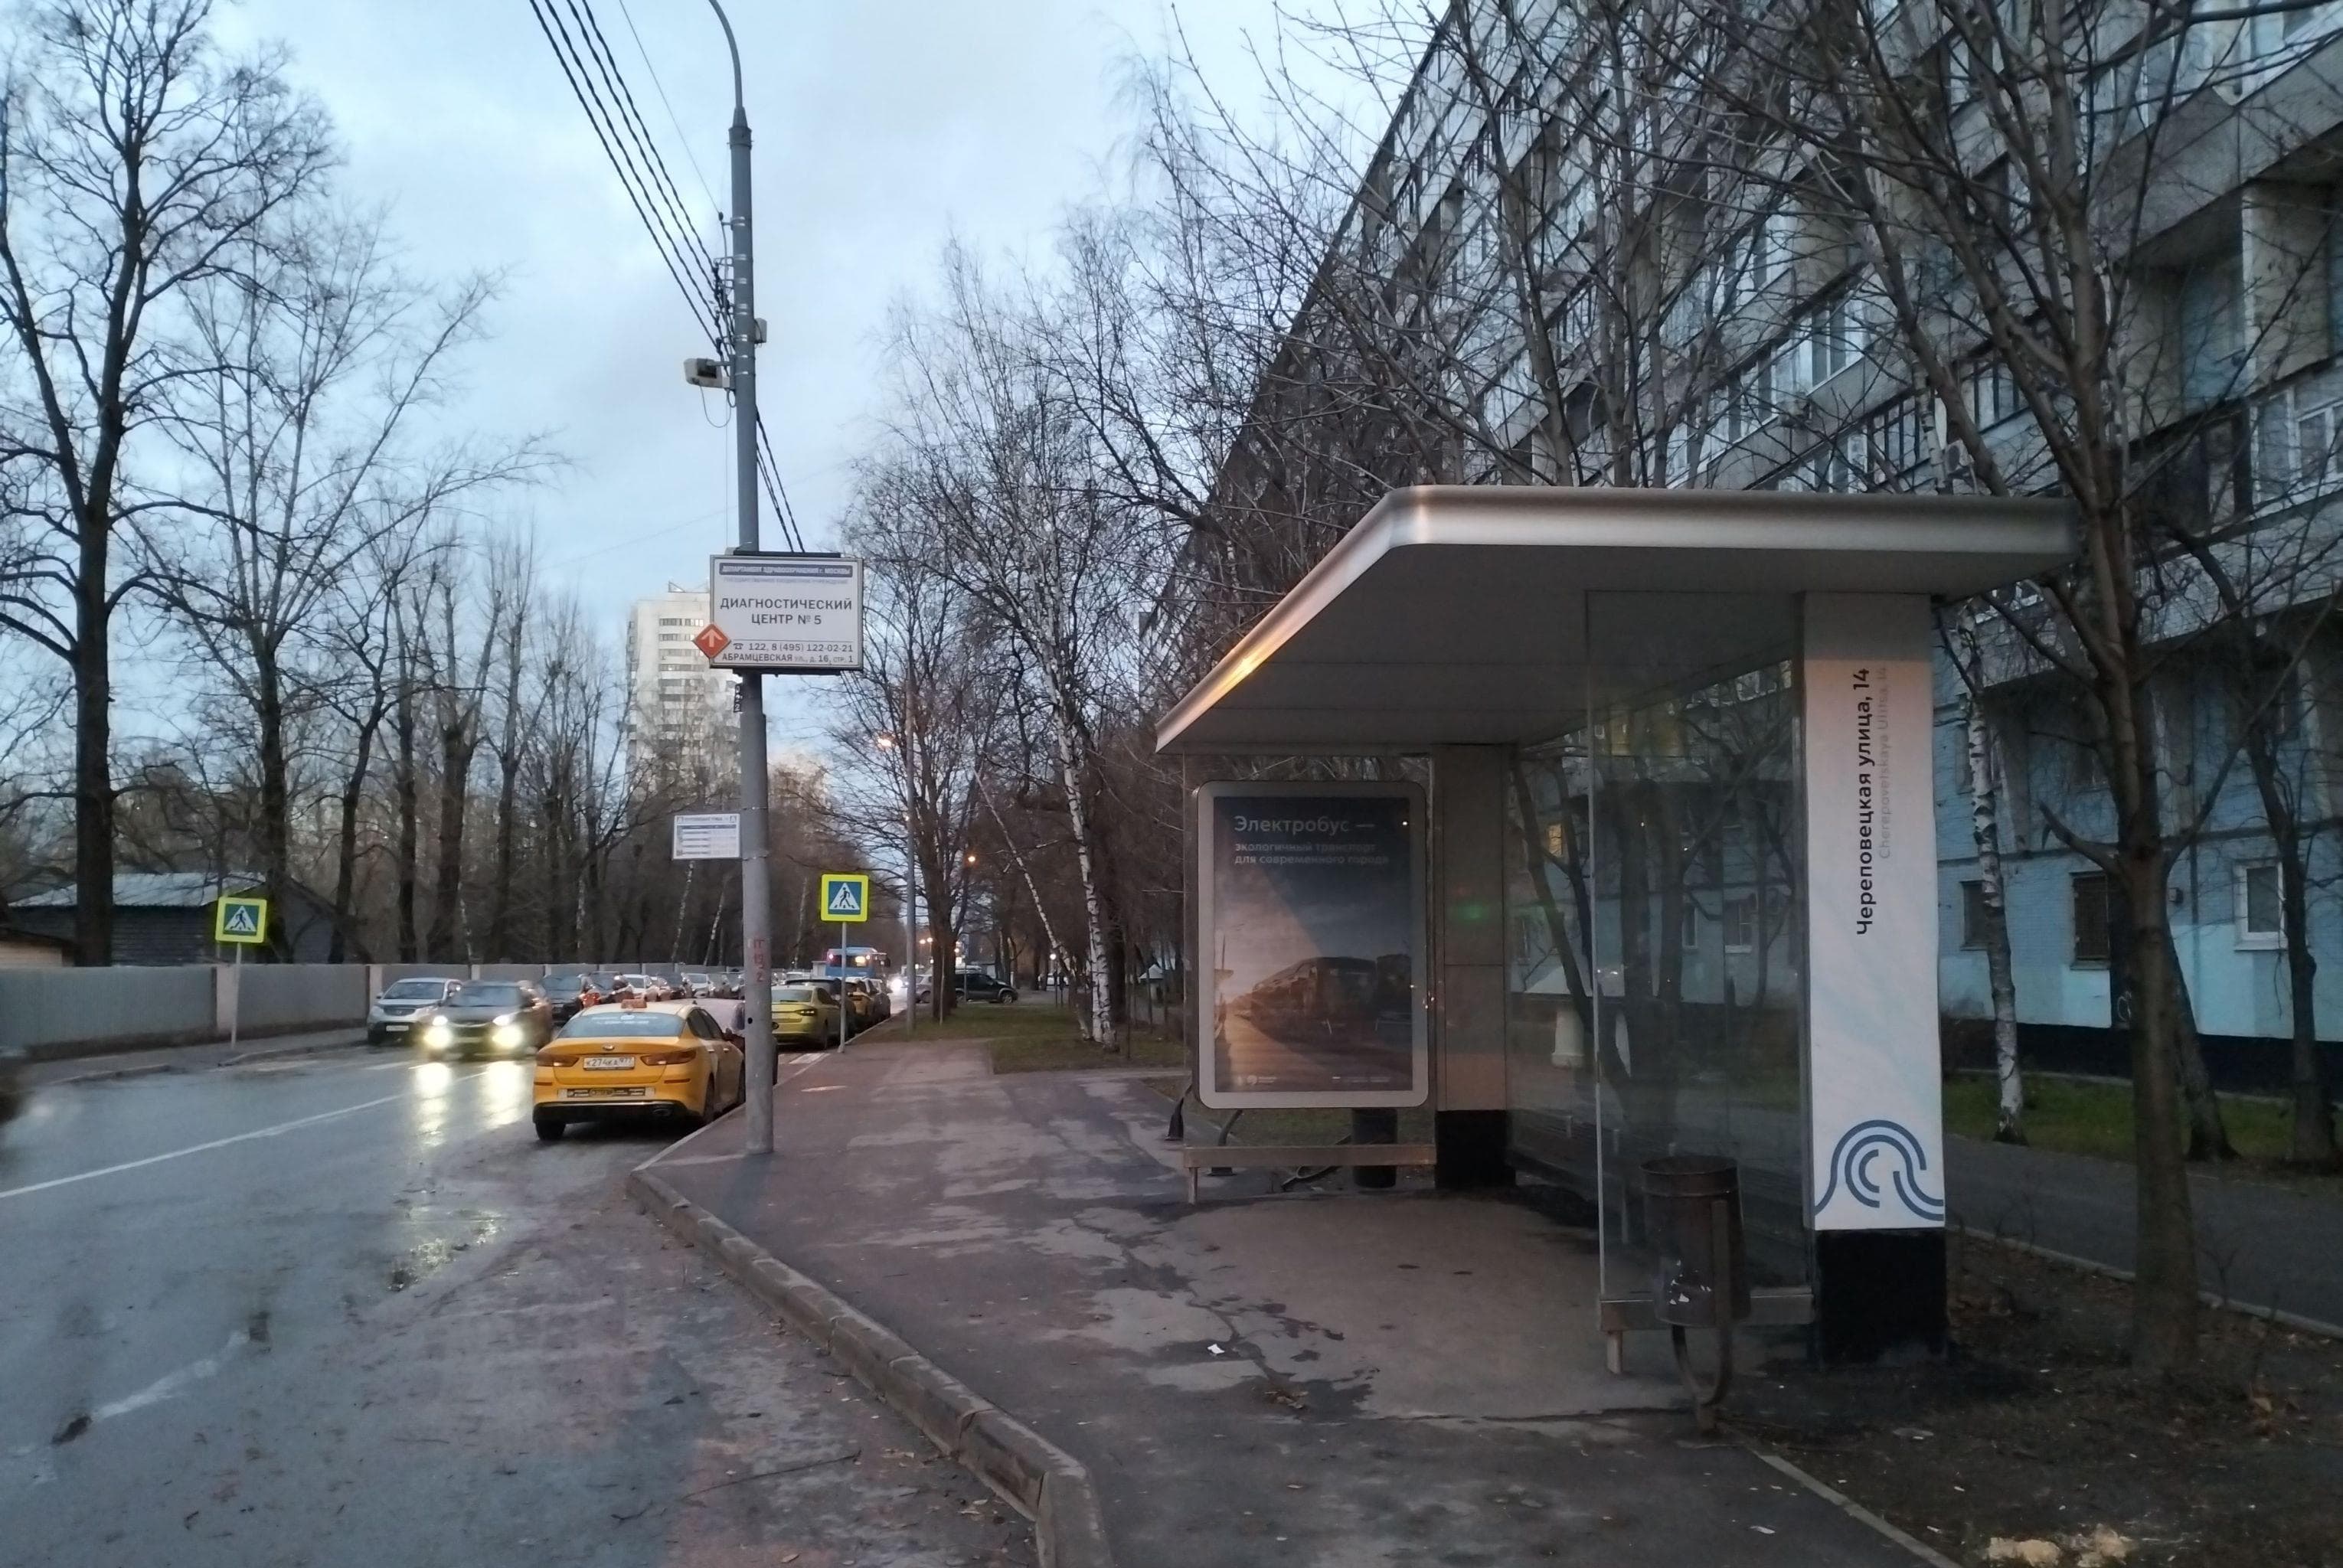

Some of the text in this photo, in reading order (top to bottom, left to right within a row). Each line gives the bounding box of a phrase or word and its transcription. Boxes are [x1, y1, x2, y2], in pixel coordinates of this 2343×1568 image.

[720, 597, 852, 610] ДИАГНОСТИЧЕСКИЙ
[751, 614, 793, 626] ЦЕНТР
[814, 615, 822, 625] 5
[779, 643, 804, 652] (495)
[807, 644, 853, 652] 122-02-21
[722, 652, 793, 662] АБРАМЦЕВСКАЯ
[1853, 668, 1877, 936] Череповецкая улица, 14
[1234, 815, 1350, 836] Электробус
[1234, 842, 1313, 852] экологичный
[1234, 856, 1256, 865] для
[1260, 856, 1346, 866] современного
